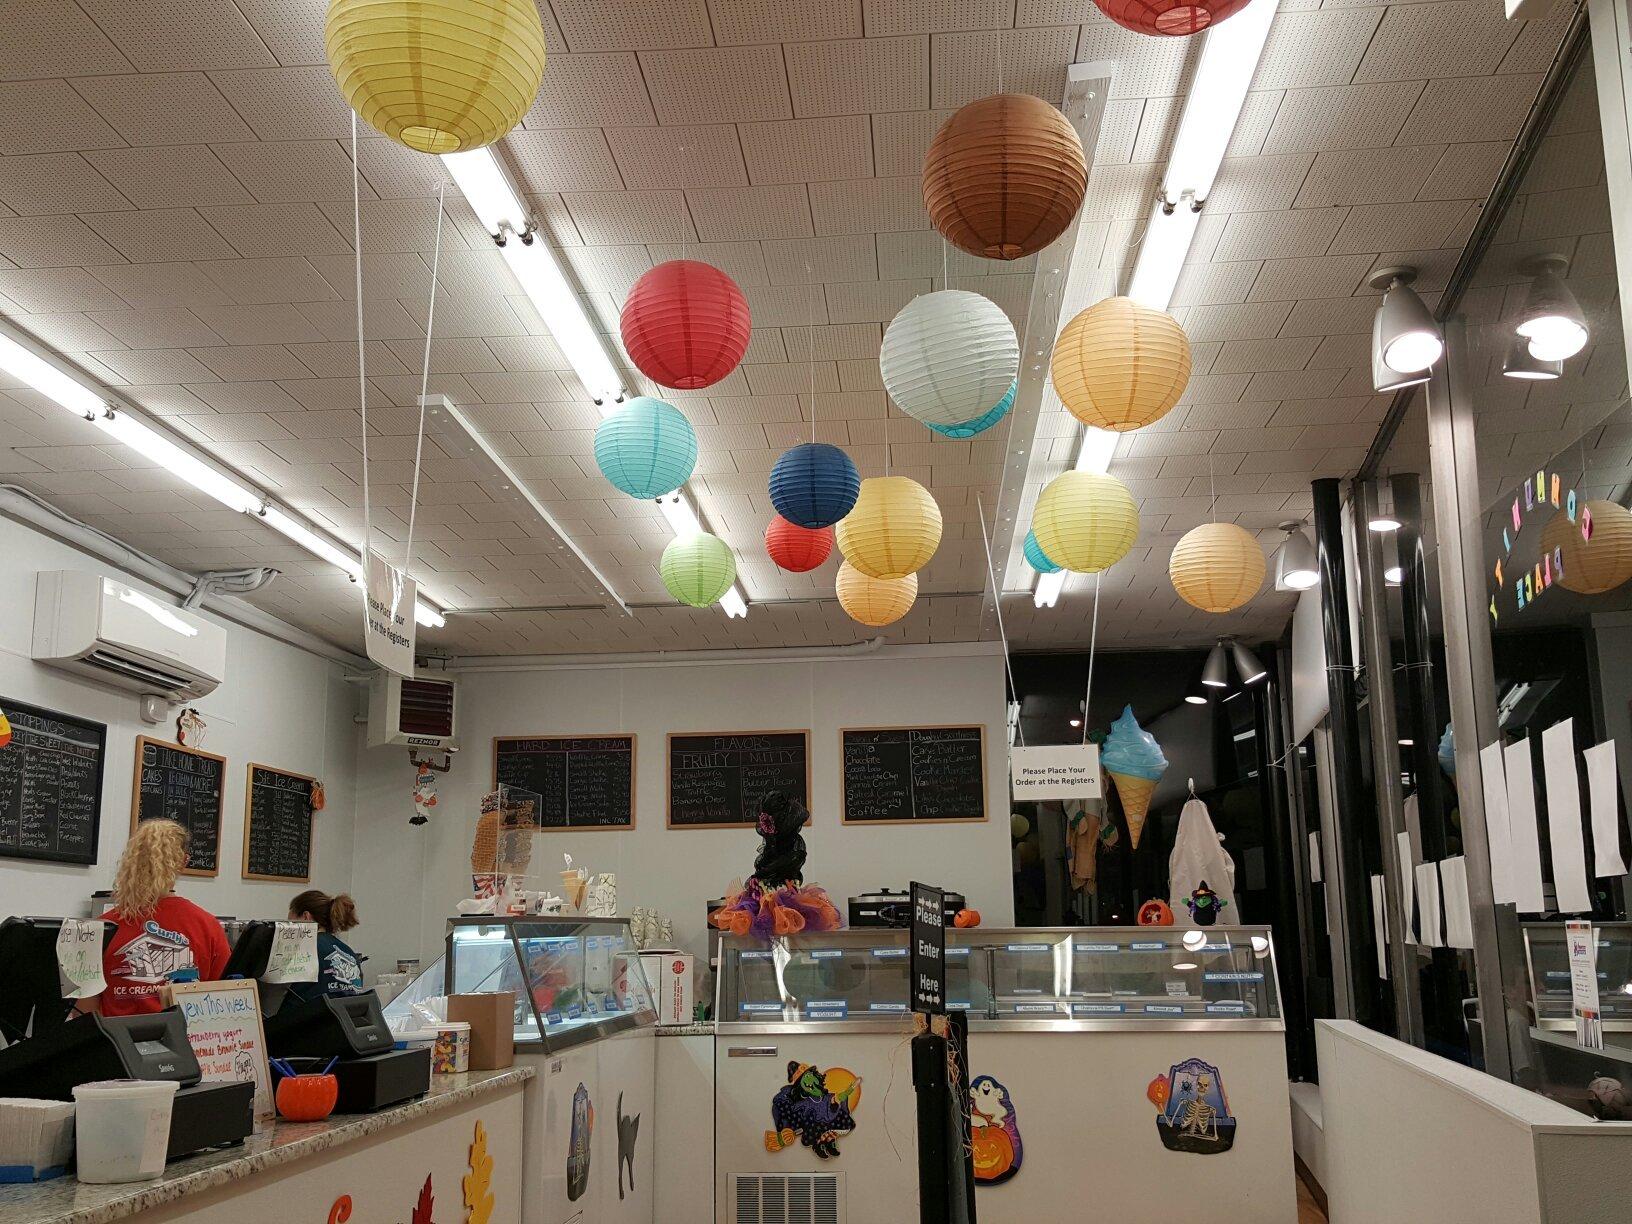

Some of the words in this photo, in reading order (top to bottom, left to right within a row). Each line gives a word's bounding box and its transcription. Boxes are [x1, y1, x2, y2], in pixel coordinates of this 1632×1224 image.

[387, 627, 410, 649] Registers
[409, 737, 439, 746] REZNOR
[516, 740, 551, 751] HARD
[560, 740, 581, 750] ICE
[713, 737, 771, 751] FLAVORS
[845, 745, 876, 755] Vanilla
[912, 745, 935, 756] Cake
[683, 752, 730, 769] FRUITY
[749, 751, 796, 765] NUTTY
[845, 755, 881, 765] Chocolate
[142, 768, 163, 783] CAKES
[742, 767, 781, 777] Pistachio
[882, 771, 899, 781] Chip
[1068, 766, 1086, 774] Your
[274, 773, 286, 787] Ice
[772, 776, 798, 788] Pecan
[1061, 777, 1095, 786] Registers
[672, 797, 703, 806] Banana
[704, 796, 726, 804] Oreo
[848, 806, 889, 817] Coffee
[916, 904, 942, 928] Please
[75, 923, 96, 943] Note
[297, 924, 313, 940] Note
[918, 939, 940, 959] Enter
[327, 982, 339, 990] ICE
[919, 973, 939, 993] Here
[113, 986, 127, 996] ICE
[128, 984, 161, 996] CREAM
[203, 993, 225, 1015] This
